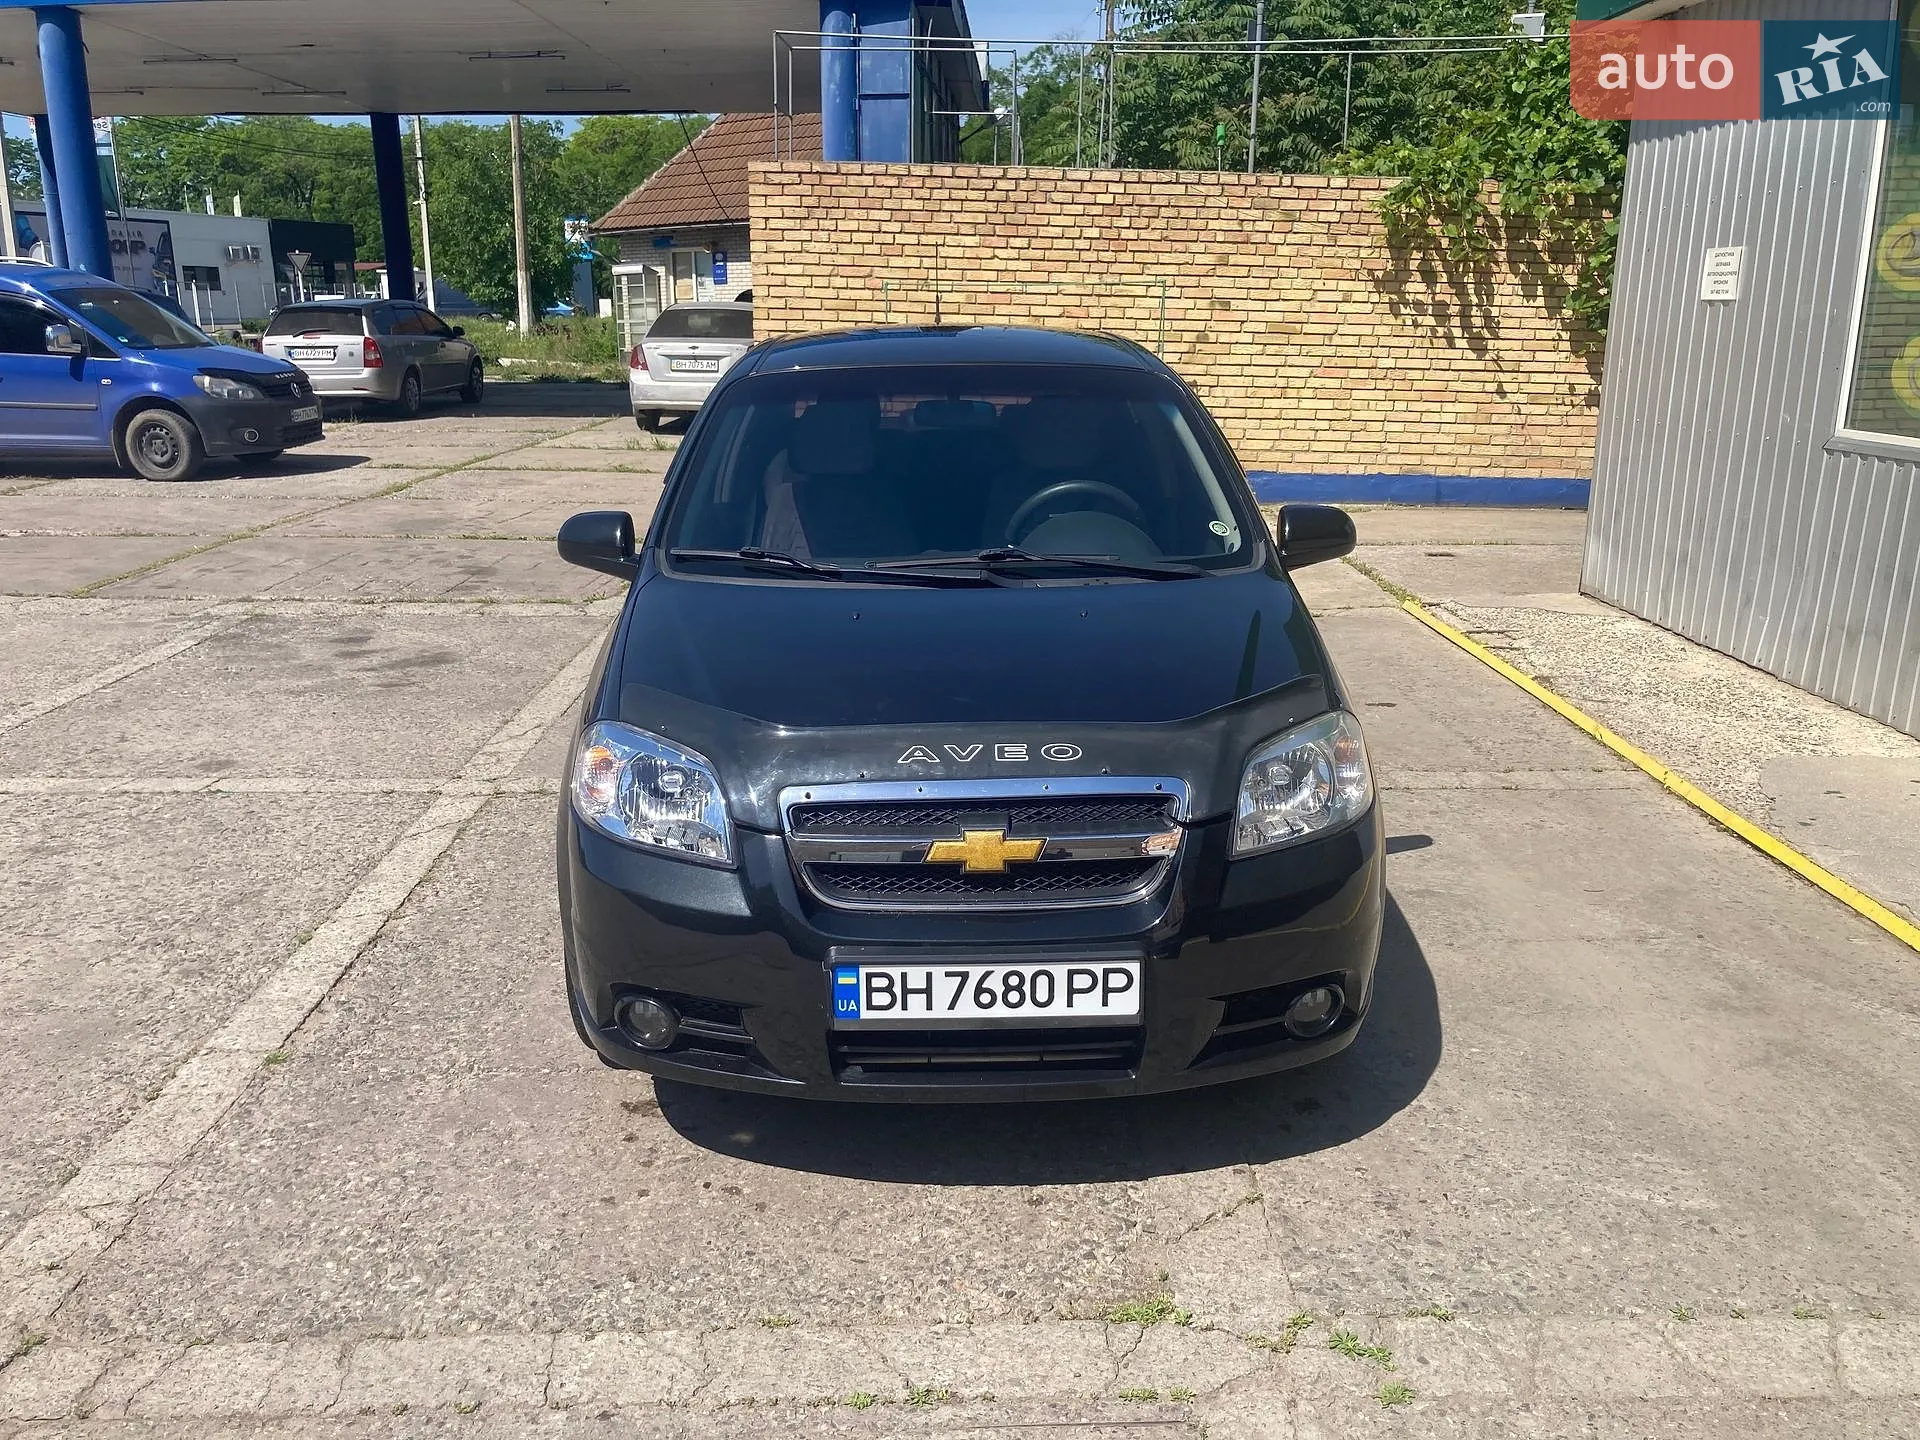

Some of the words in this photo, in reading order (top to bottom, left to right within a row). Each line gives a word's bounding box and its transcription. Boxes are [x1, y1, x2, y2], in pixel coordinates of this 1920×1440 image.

[706, 361, 717, 369] AM
[897, 743, 1083, 763] AVEO
[865, 971, 933, 1011] BH
[944, 969, 1055, 1011] 7680
[1066, 967, 1134, 1008] PP
[838, 1000, 858, 1011] UA
